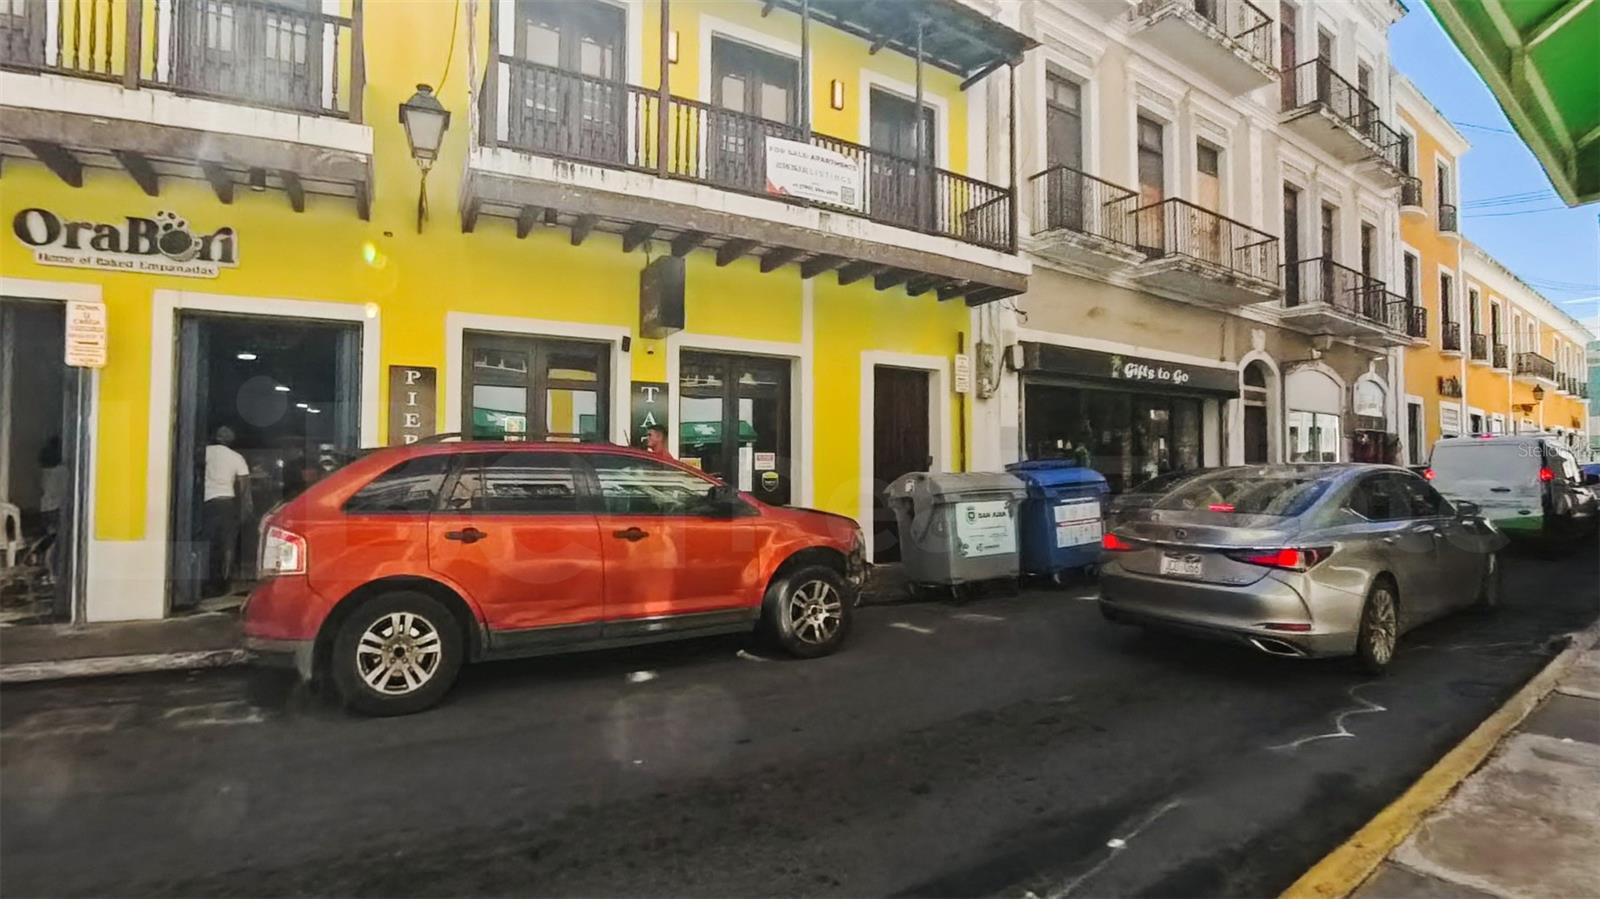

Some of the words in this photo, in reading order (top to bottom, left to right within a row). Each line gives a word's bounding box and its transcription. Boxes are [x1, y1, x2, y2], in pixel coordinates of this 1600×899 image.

[38, 252, 75, 264] Home
[79, 256, 91, 265] of
[96, 257, 134, 269] Baked
[140, 261, 215, 276] Empanadas
[1124, 362, 1156, 380] Gifts
[1157, 367, 1171, 380] to
[1172, 369, 1190, 385] Go
